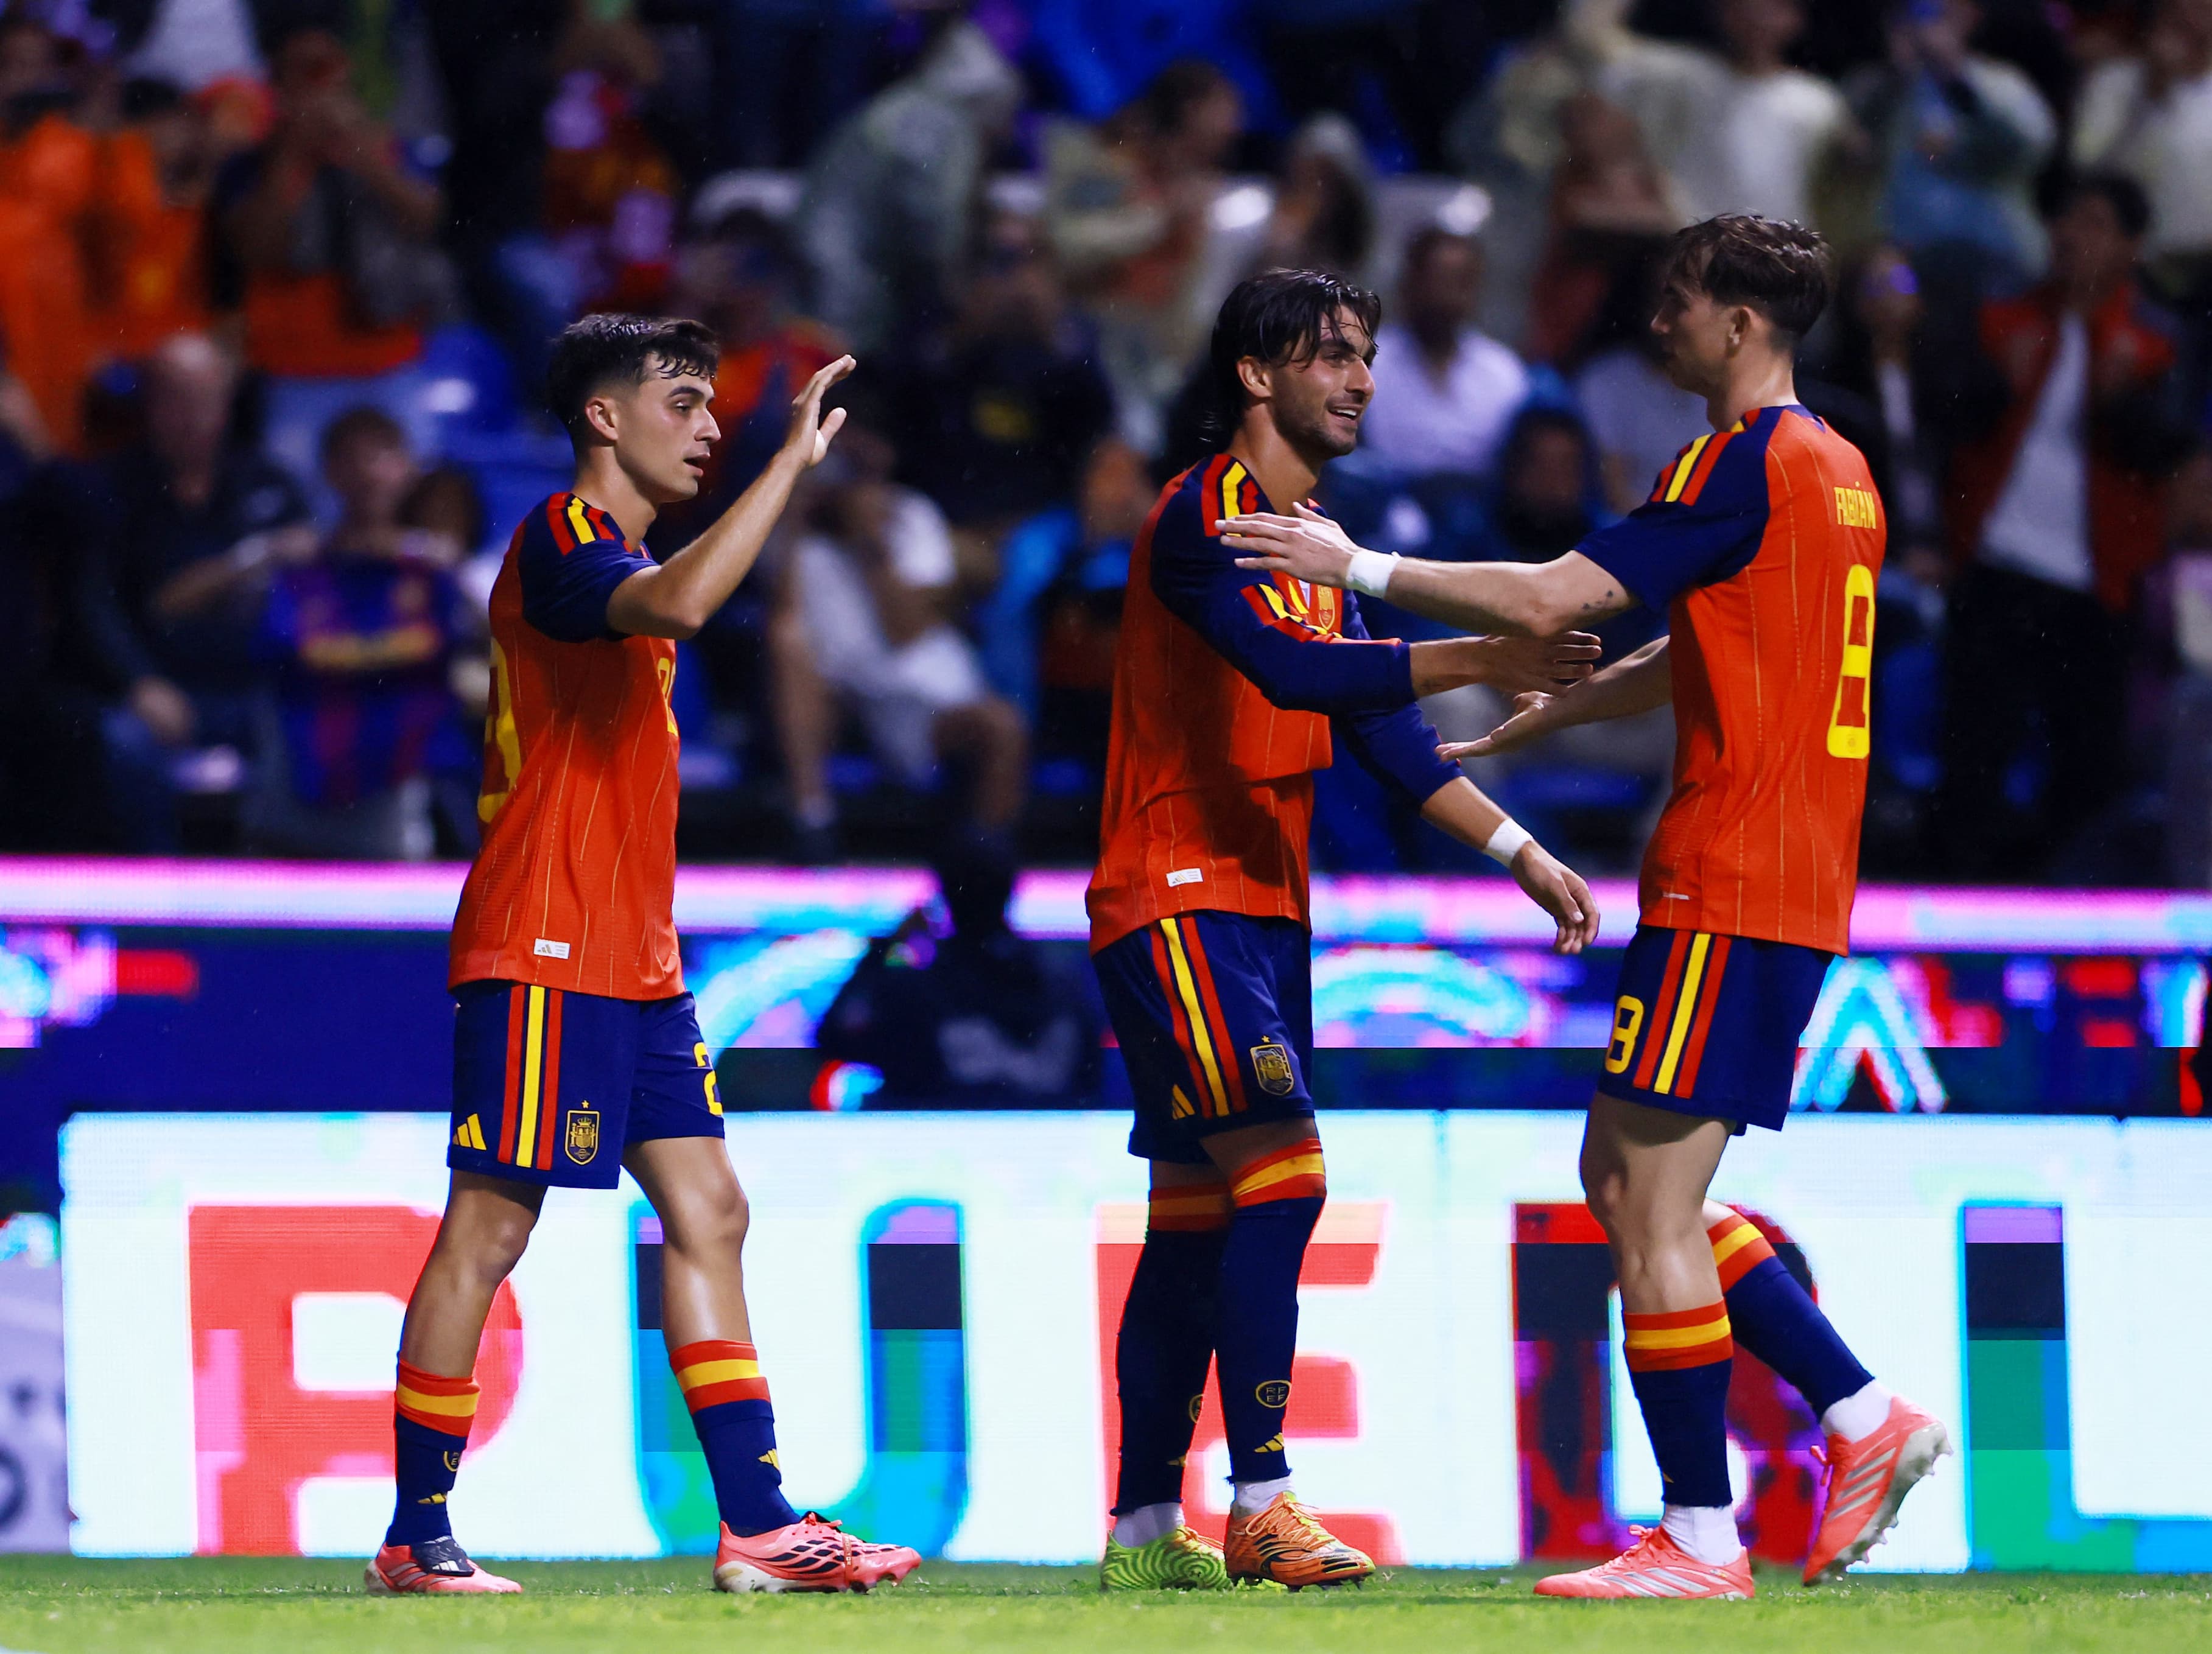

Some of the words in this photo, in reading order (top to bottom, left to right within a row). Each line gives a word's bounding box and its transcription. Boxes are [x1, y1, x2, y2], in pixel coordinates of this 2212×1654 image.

[1834, 481, 1876, 529] FABIÁN
[1827, 564, 1875, 759] 8
[1605, 995, 1644, 1074] 8
